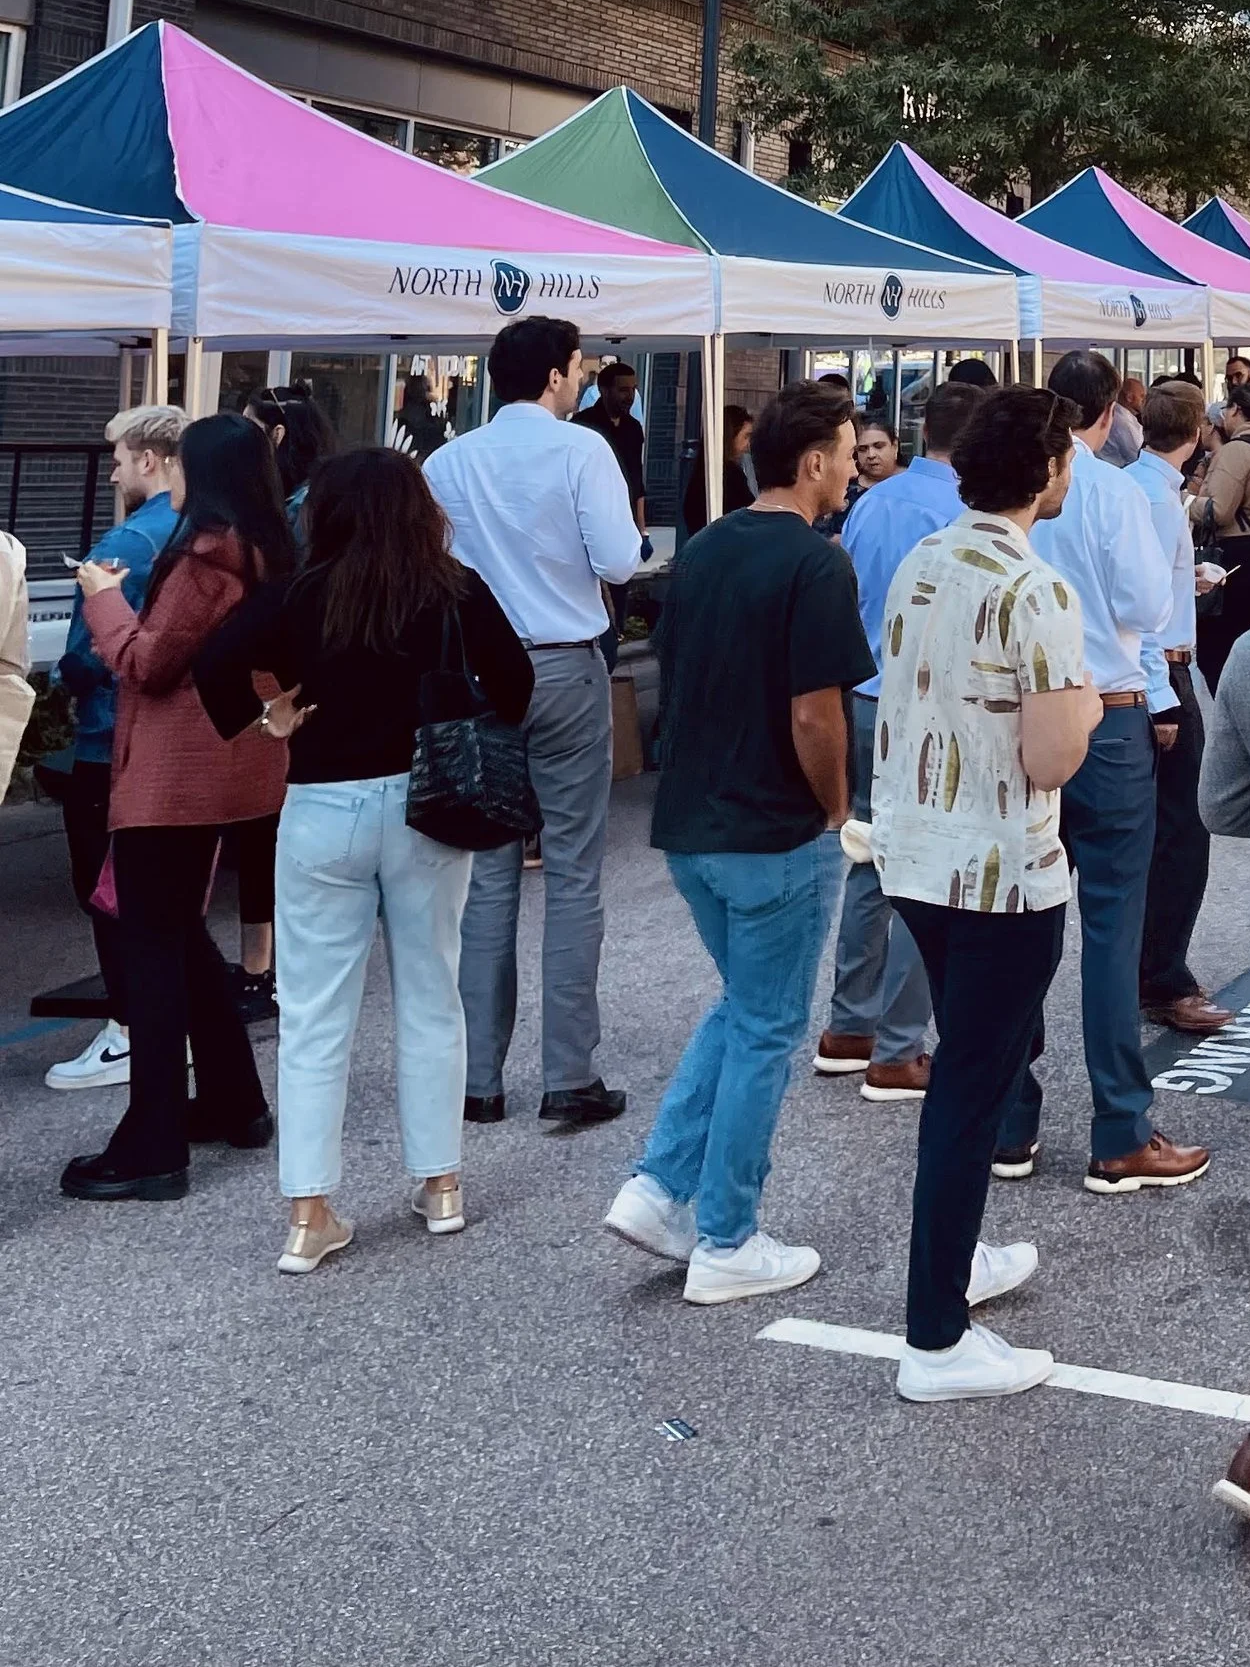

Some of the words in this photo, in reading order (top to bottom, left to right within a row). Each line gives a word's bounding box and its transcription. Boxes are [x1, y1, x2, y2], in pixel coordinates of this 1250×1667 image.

[388, 266, 482, 296] NORTH
[539, 272, 602, 299] HILLS
[823, 282, 877, 305] NORTH
[907, 287, 947, 310] HILLS
